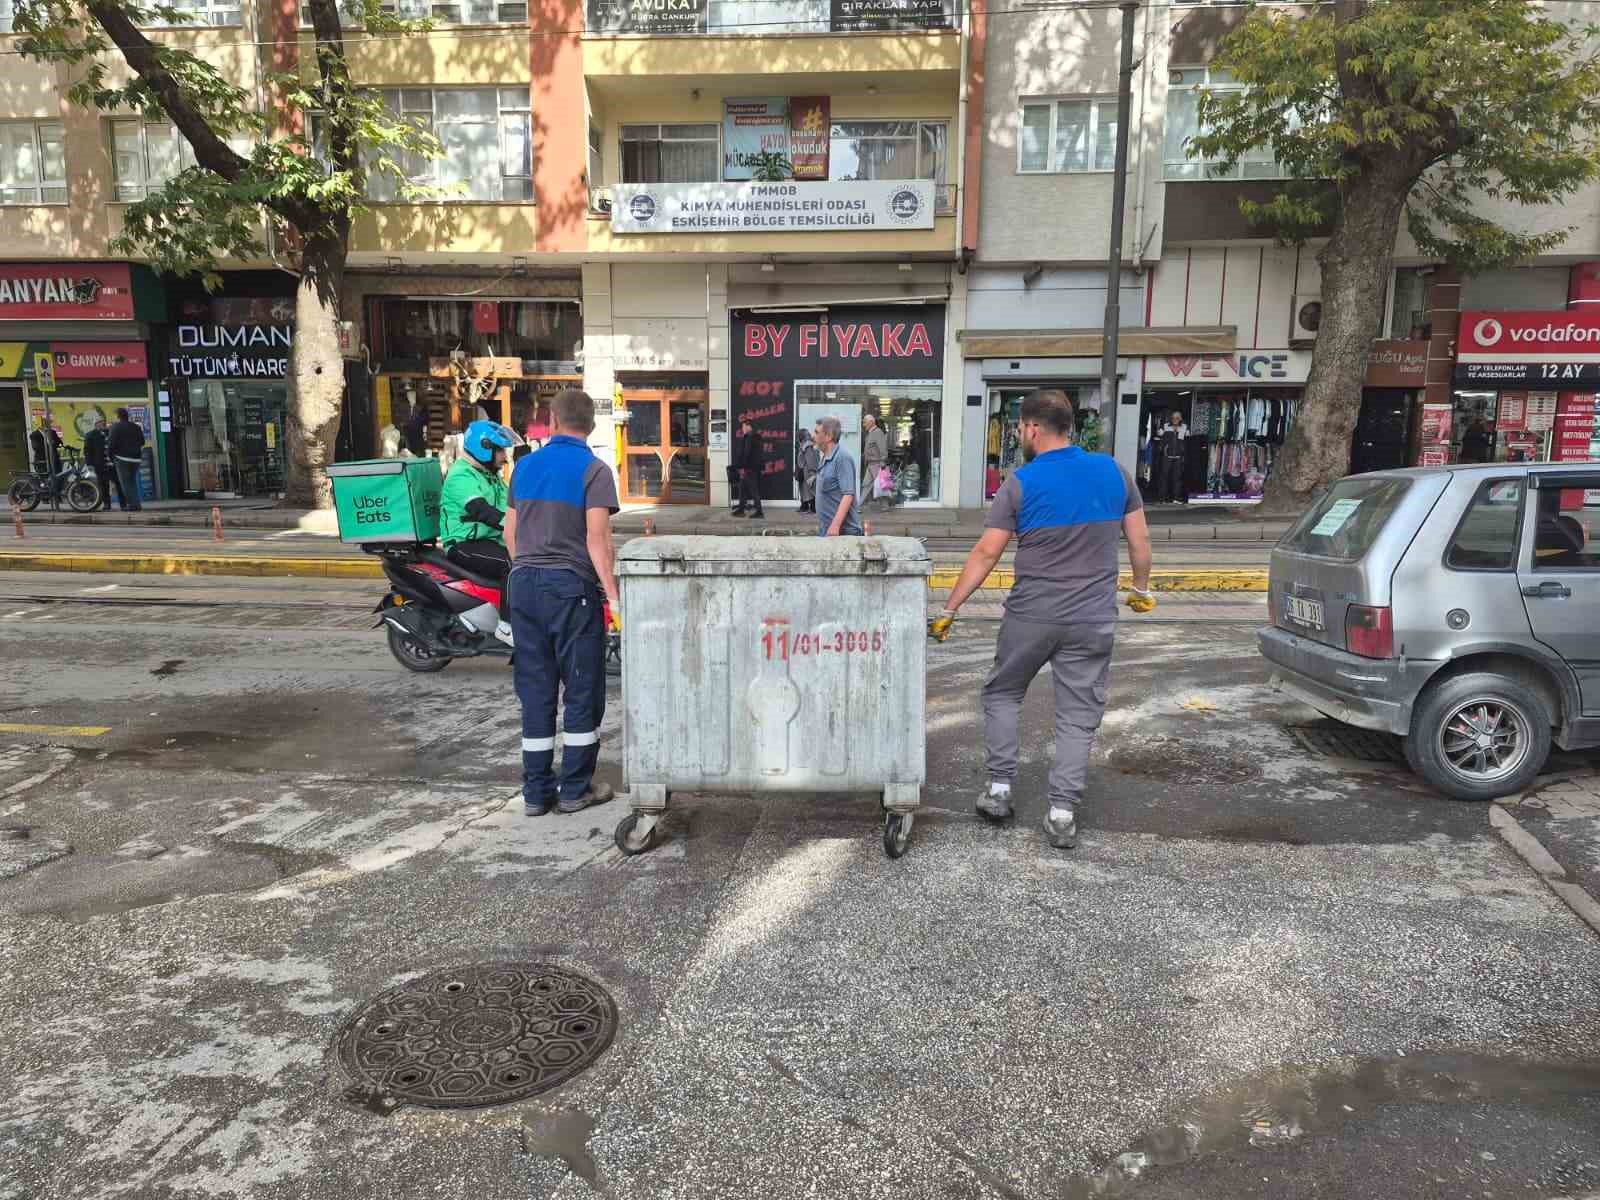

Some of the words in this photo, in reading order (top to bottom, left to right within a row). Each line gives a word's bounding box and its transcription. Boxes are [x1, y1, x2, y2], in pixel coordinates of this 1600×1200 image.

[750, 185, 797, 196] TMMOB
[680, 200, 722, 212] KİMYA
[826, 199, 866, 211] ODASI
[671, 214, 739, 228] ESKİŞEHİR
[743, 214, 786, 227] BÖLGE
[788, 213, 876, 226] TEMSİLCİLİĞİ
[178, 325, 292, 347] DUMAN
[744, 323, 792, 358] BY
[799, 314, 933, 358] FİYAKA
[1510, 323, 1600, 342] vodafon
[70, 354, 115, 368] GANYAN
[169, 354, 228, 376] TÜTÜN
[1541, 364, 1558, 378] 12
[1562, 364, 1584, 378] AY
[353, 495, 388, 509] Uber
[356, 510, 391, 524] Eats
